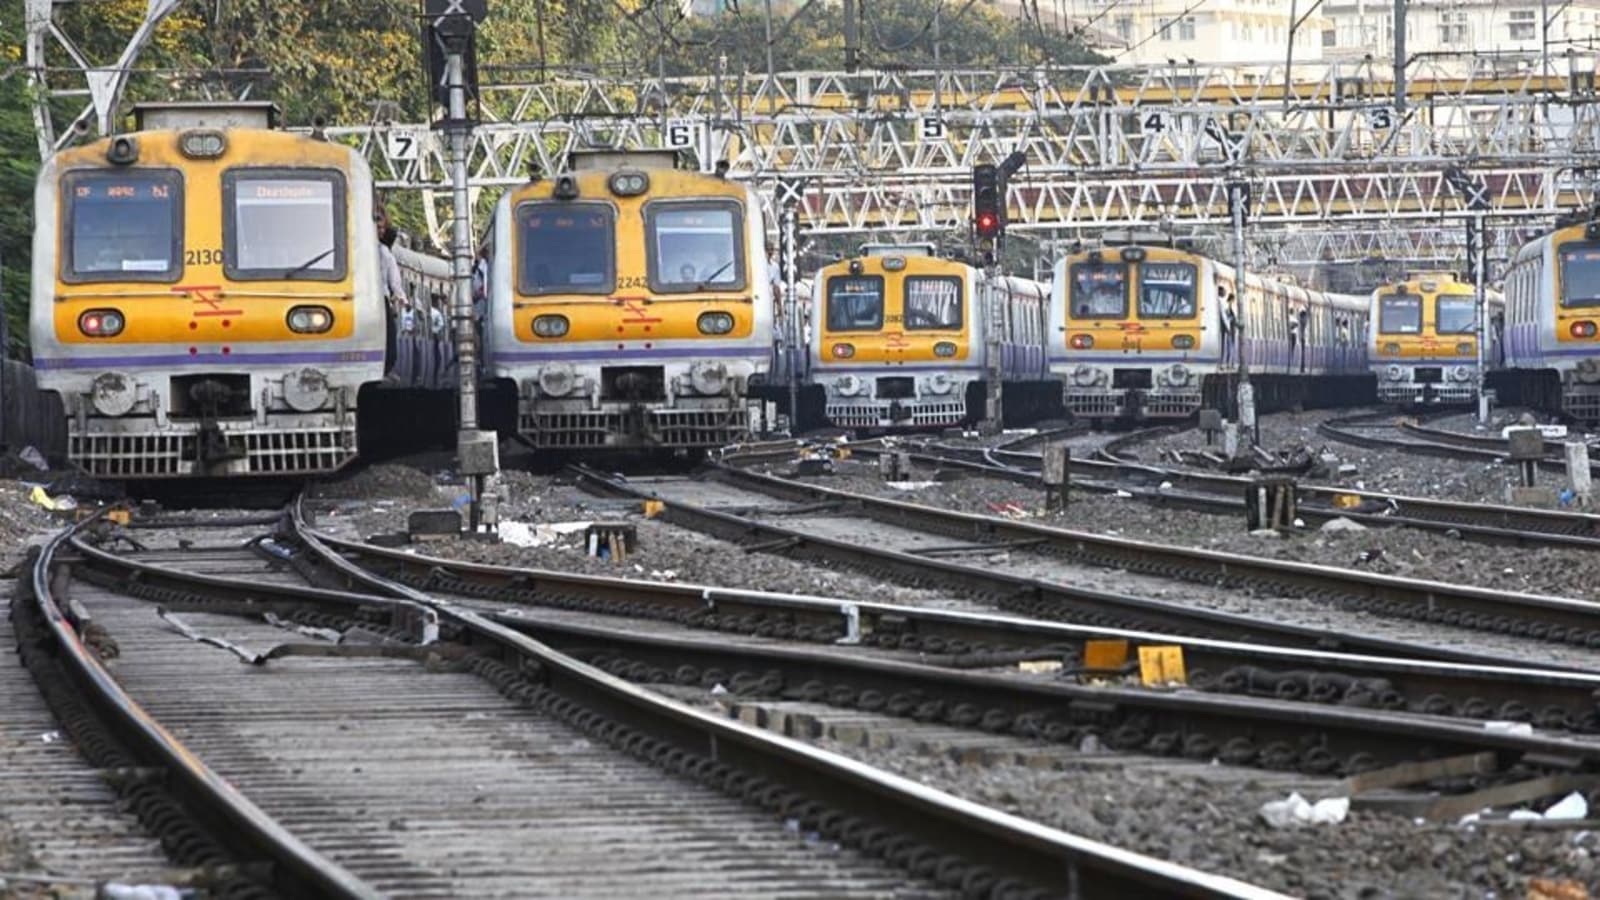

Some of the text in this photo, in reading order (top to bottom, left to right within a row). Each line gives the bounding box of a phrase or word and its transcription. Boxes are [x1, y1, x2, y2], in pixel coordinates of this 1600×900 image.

[924, 118, 943, 137] 5
[1144, 114, 1165, 133] 4
[1372, 108, 1391, 129] 3
[670, 126, 689, 146] 6
[394, 138, 413, 157] 7
[186, 249, 223, 265] 2130
